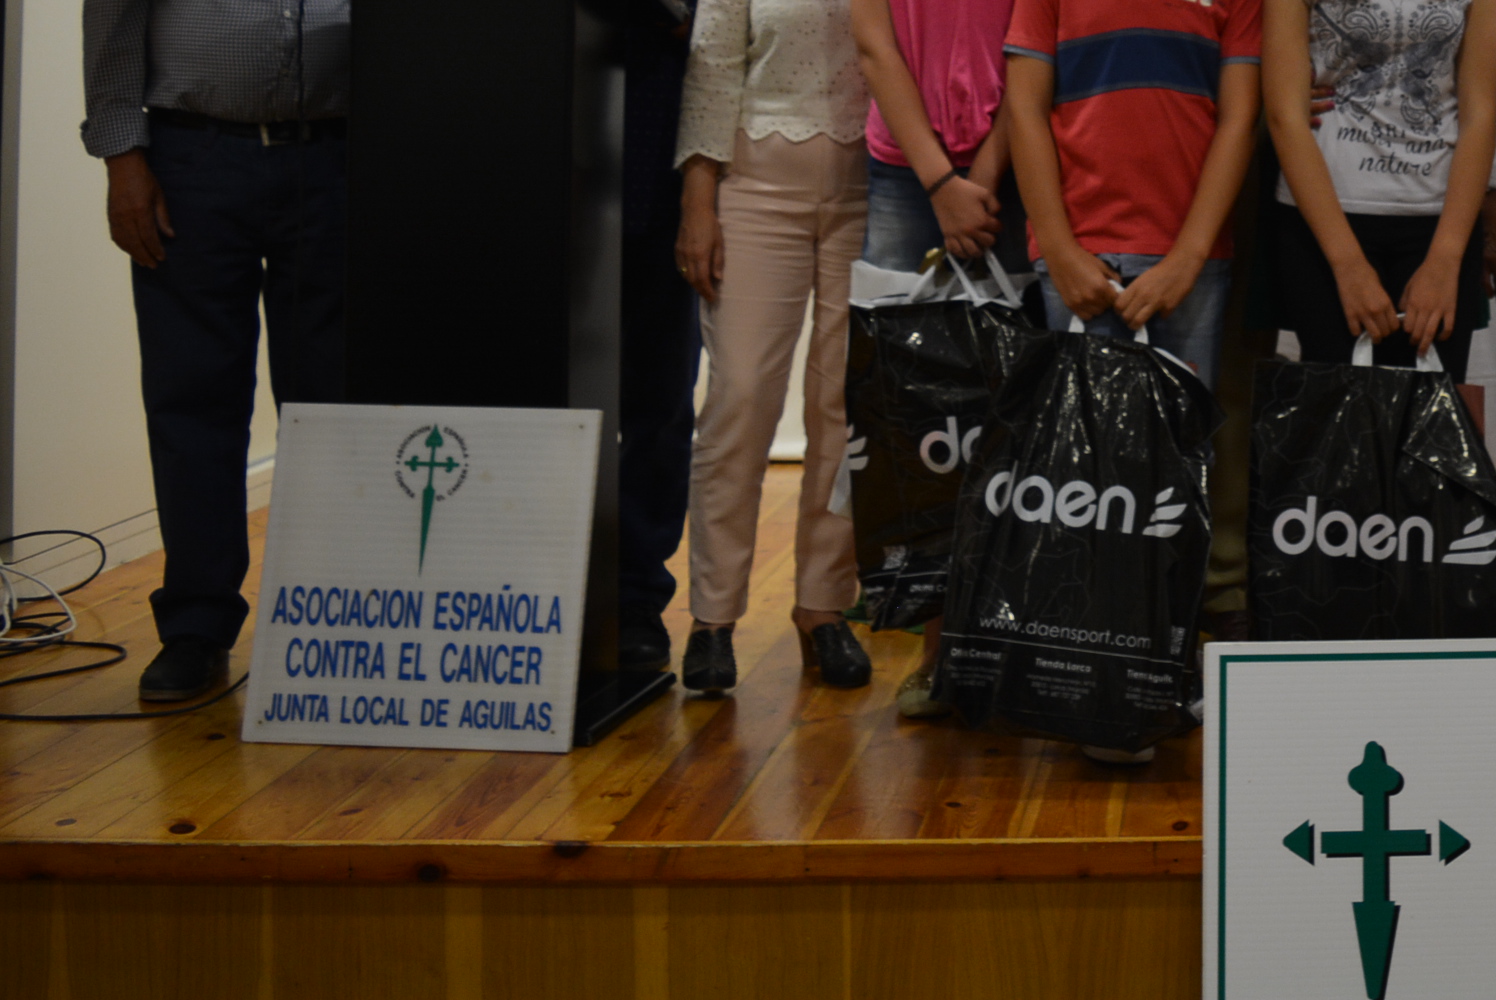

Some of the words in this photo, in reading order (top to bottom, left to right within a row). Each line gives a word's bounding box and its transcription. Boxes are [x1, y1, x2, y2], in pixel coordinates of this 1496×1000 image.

[1359, 152, 1432, 176] nature
[985, 461, 1136, 535] daen
[1272, 495, 1434, 563] daen
[271, 586, 423, 629] ASOCIACION
[433, 584, 562, 634] ESPAÑOLA
[979, 616, 1152, 649] www.daensport.com
[286, 638, 385, 680] CONTRA
[398, 642, 427, 682] EL
[440, 643, 542, 685] CANCER
[264, 693, 329, 722] JUNTA
[340, 696, 410, 726] LOCAL
[420, 699, 448, 727] DE
[459, 701, 553, 732] AGUILAS
